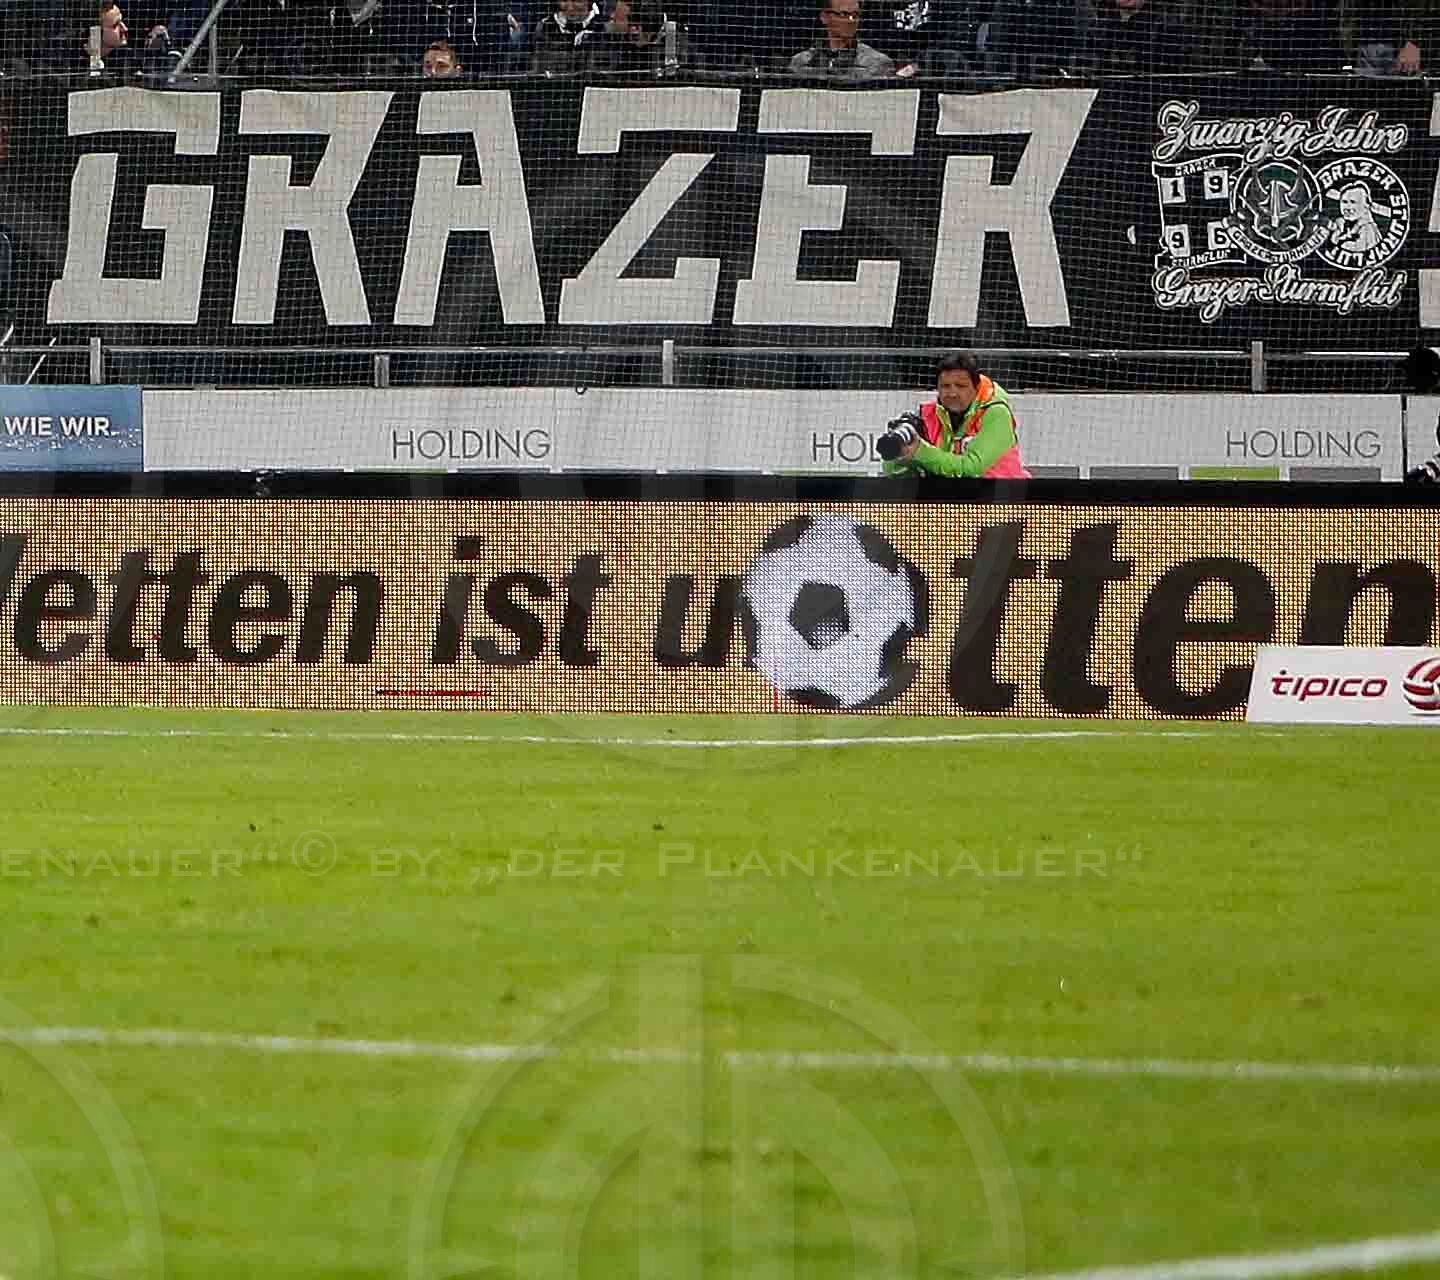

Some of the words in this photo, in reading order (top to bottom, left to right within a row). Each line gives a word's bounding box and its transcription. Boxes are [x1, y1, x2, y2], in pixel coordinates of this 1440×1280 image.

[1153, 100, 1311, 163] Zwanzig
[1301, 105, 1408, 155] Jahre
[48, 86, 1099, 329] GRAZER
[5, 415, 53, 438] WIE
[390, 427, 552, 461] HOLDING
[1226, 430, 1382, 459] HOLDING
[433, 534, 613, 668] ist
[1269, 668, 1389, 702] tipico
